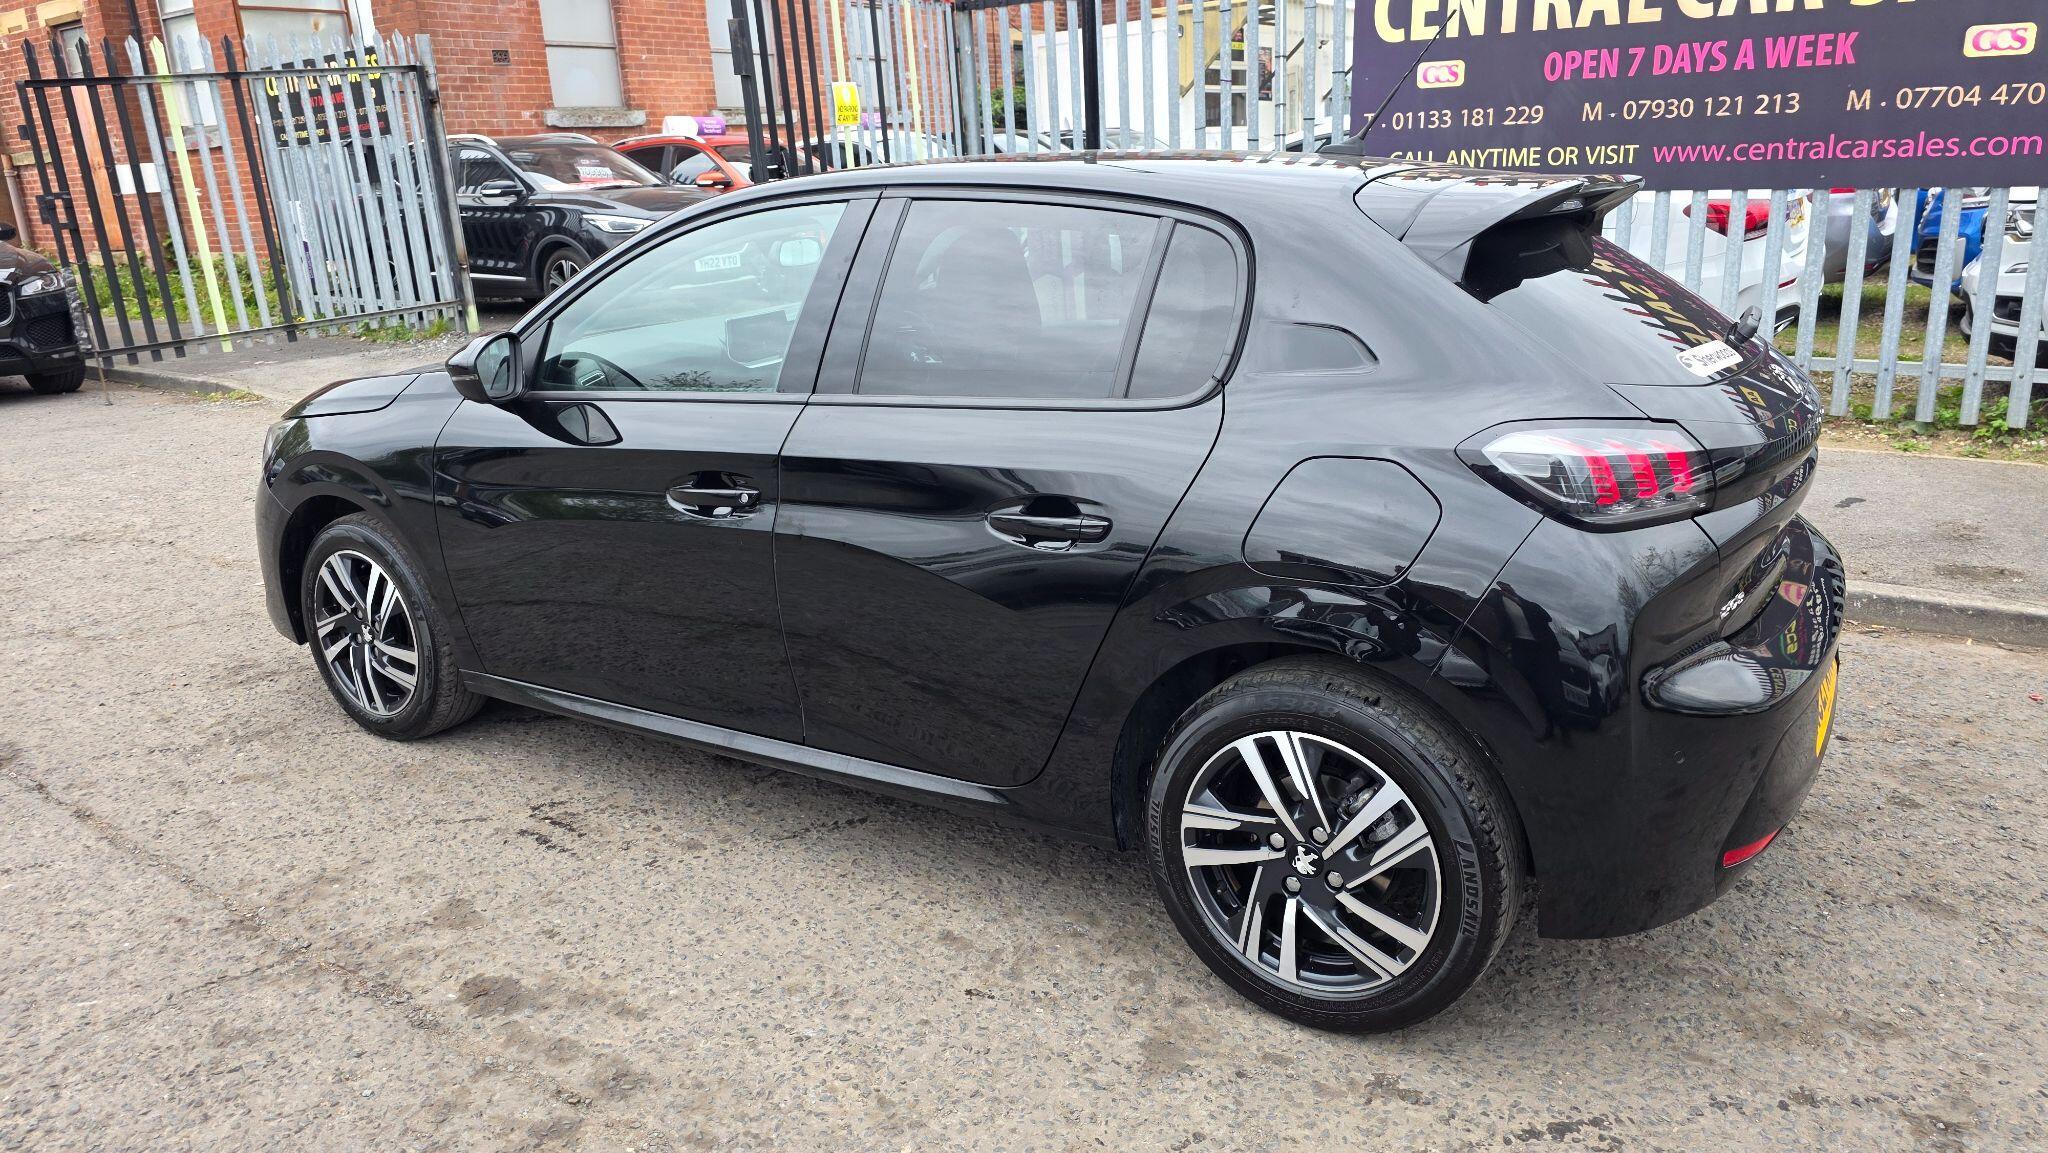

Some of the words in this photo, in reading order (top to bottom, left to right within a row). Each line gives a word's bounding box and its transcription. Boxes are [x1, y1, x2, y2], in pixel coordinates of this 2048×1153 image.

[1544, 48, 1620, 81] OPEN
[1628, 47, 1646, 77] 7
[1652, 40, 1728, 75] DAYS
[1733, 38, 1755, 71] A
[1765, 31, 1859, 68] WEEK
[1391, 109, 1453, 131] 01133
[1461, 107, 1495, 127] 181
[1502, 105, 1545, 125] 229
[1622, 98, 1695, 120] 07930
[1704, 95, 1743, 117] 121
[1753, 92, 1801, 115] 213
[1895, 85, 1982, 110] 07704
[1990, 82, 2046, 106] 470
[1446, 147, 1542, 168] ANYTIME
[1547, 146, 1579, 166] OR
[1585, 144, 1640, 165] VISIT
[1652, 130, 2043, 163] www.centralcarsales.com
[1455, 840, 1479, 936] LANDSAIL
